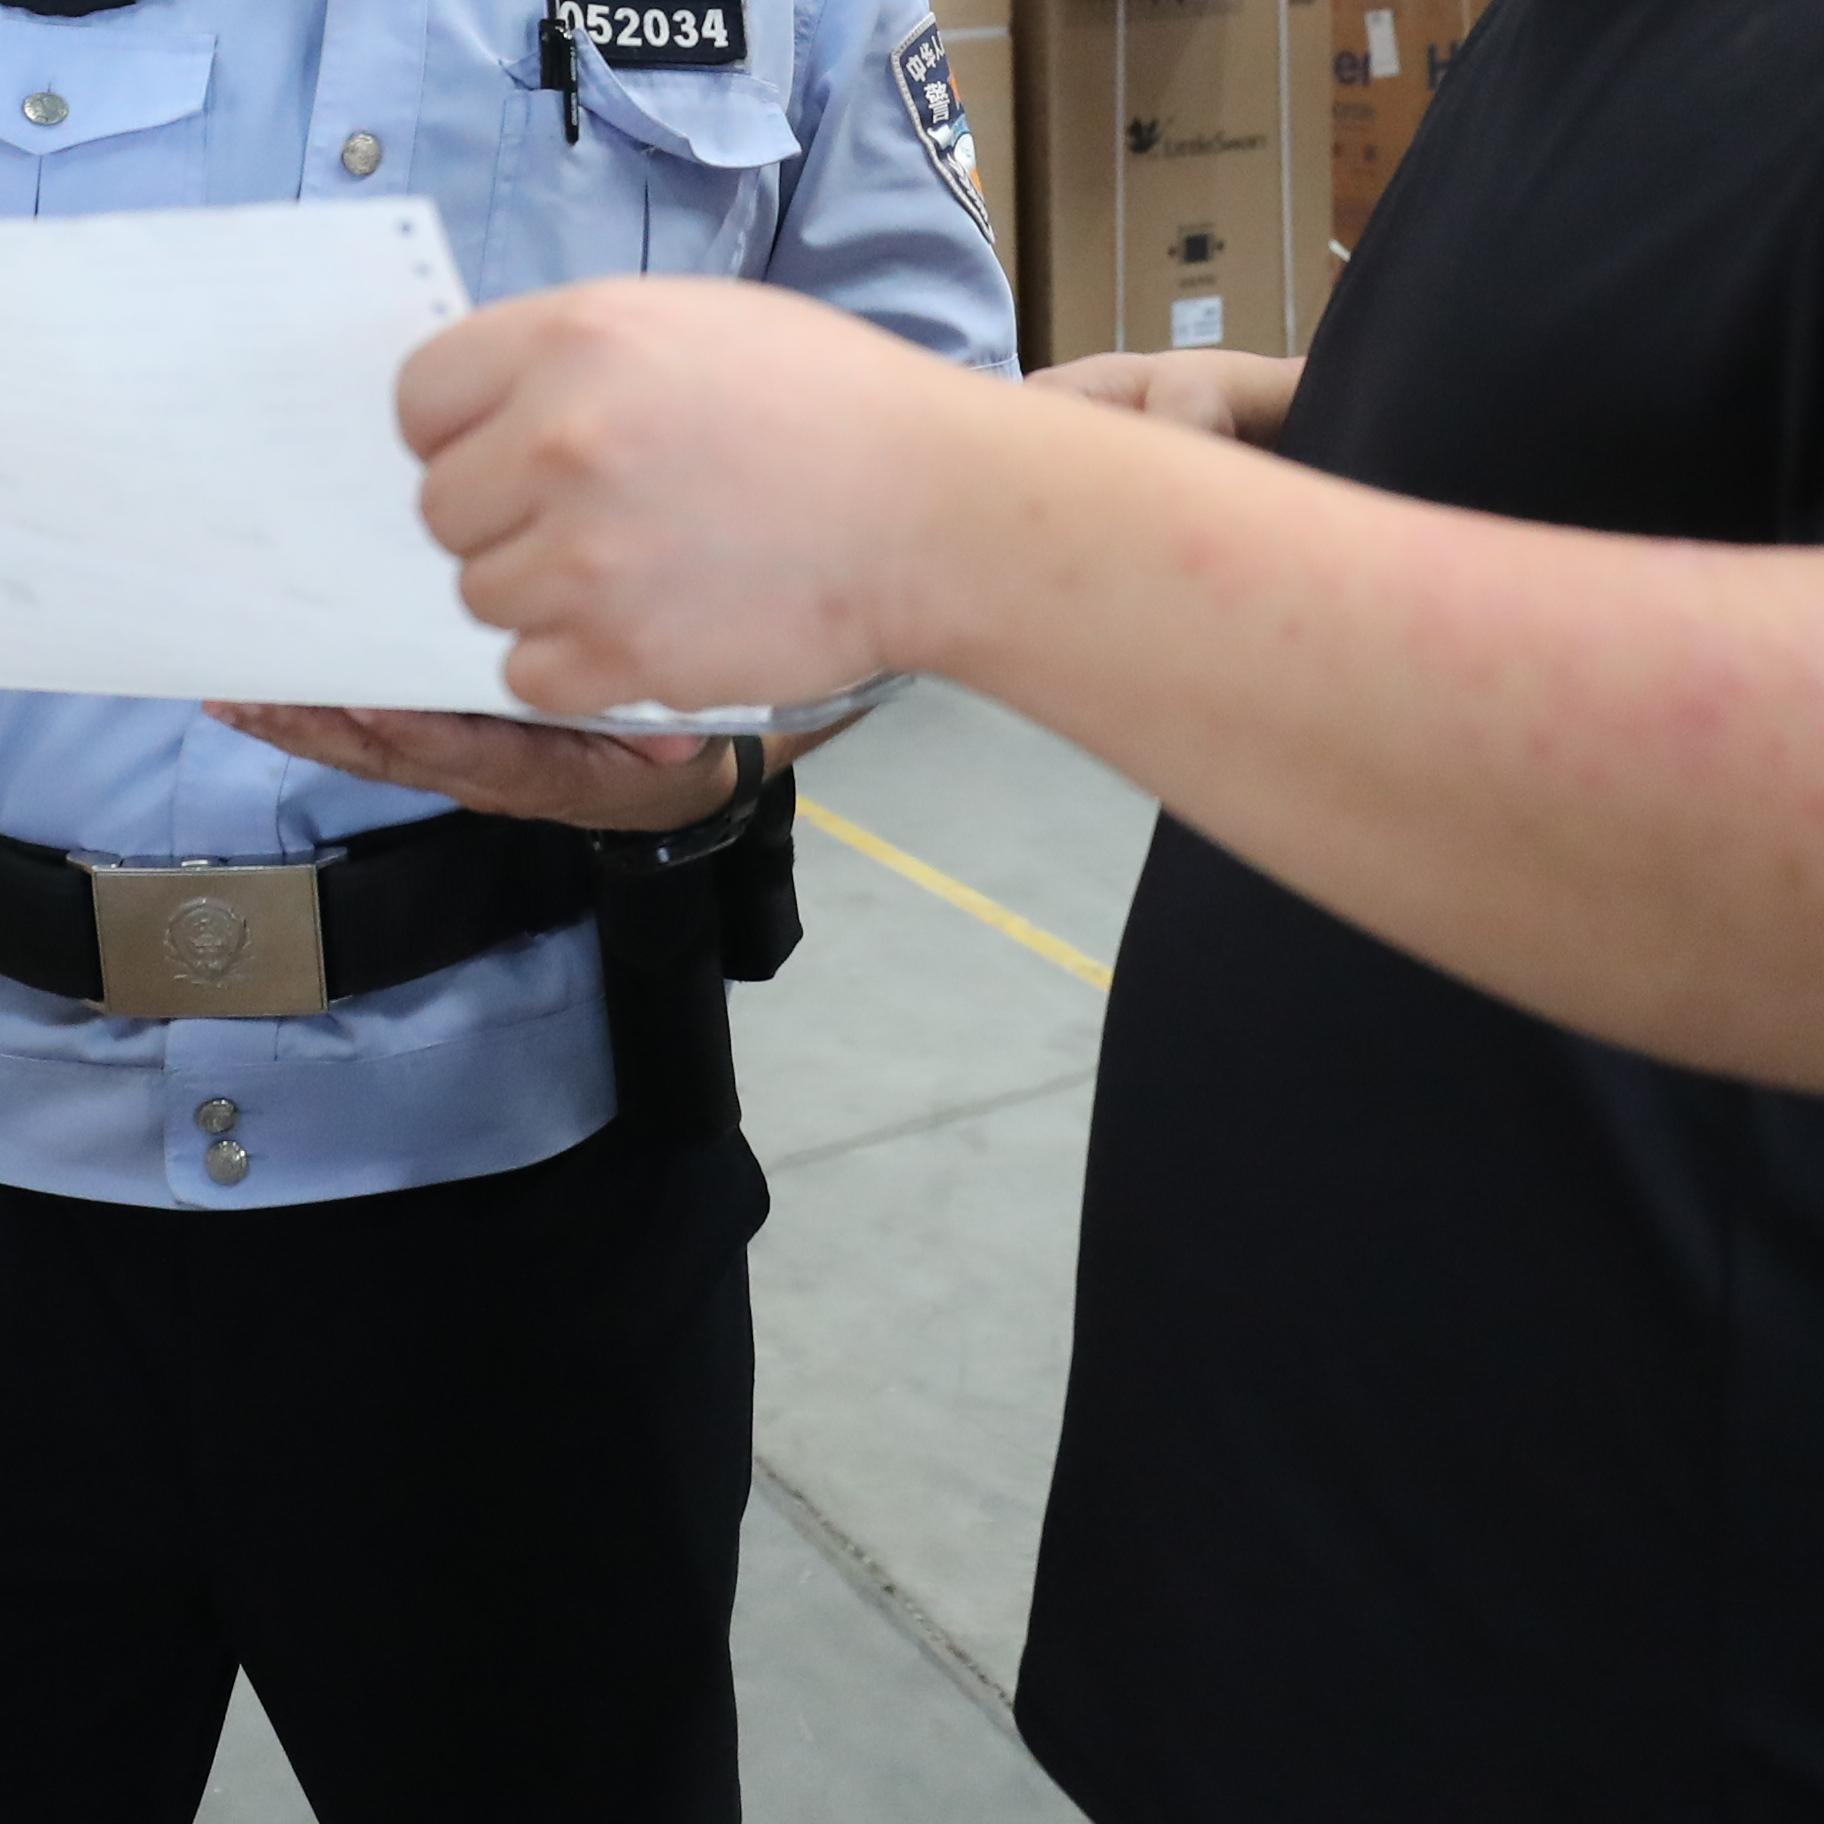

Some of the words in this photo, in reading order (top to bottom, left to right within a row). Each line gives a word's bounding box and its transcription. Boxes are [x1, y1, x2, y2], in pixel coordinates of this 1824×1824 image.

[560, 1, 729, 49] 052034
[905, 31, 946, 83] 中华人
[924, 79, 951, 125] 警
